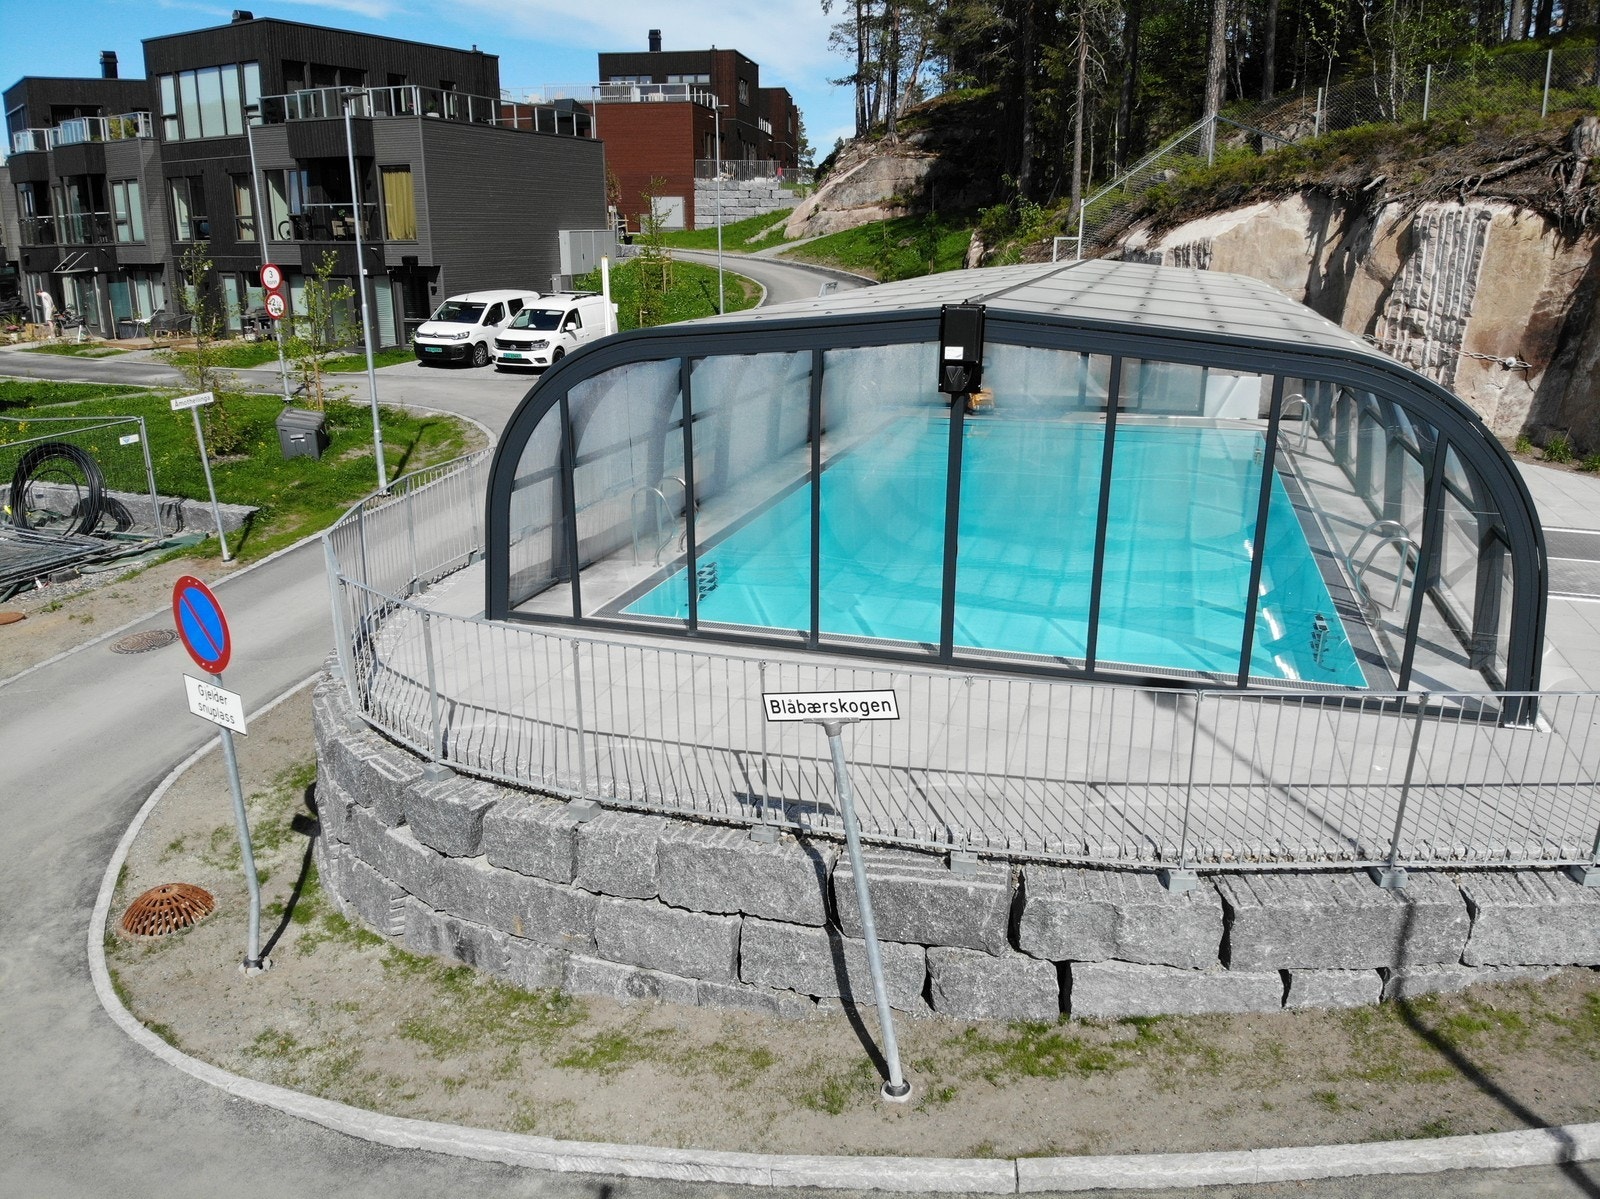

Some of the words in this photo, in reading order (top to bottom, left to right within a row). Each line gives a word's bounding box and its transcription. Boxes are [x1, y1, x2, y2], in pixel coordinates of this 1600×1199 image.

[268, 270, 274, 279] 3
[198, 684, 228, 705] Gjelder
[198, 702, 235, 724] snuplass
[770, 698, 892, 716] Blåbærskogen
